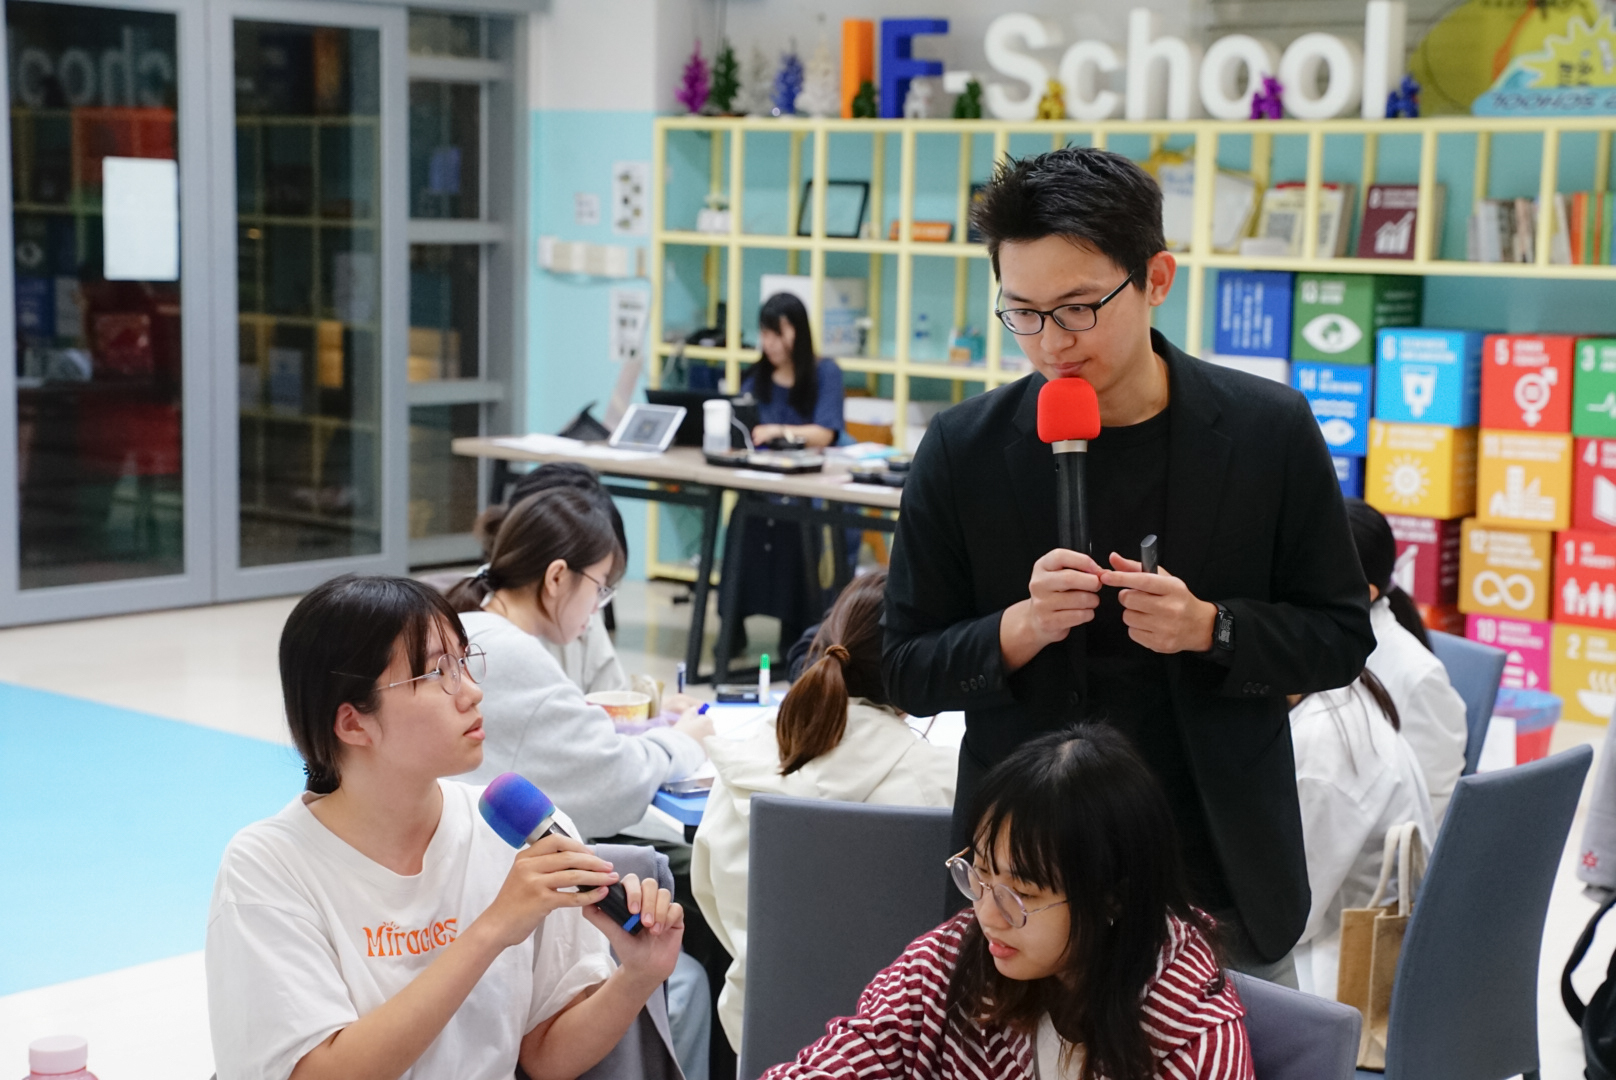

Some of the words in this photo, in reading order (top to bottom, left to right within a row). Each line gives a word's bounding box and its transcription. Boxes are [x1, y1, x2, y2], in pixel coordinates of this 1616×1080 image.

[1582, 439, 1598, 467] 4
[1564, 539, 1576, 566] 1
[1566, 632, 1582, 660] 2
[362, 917, 458, 957] Miracles
